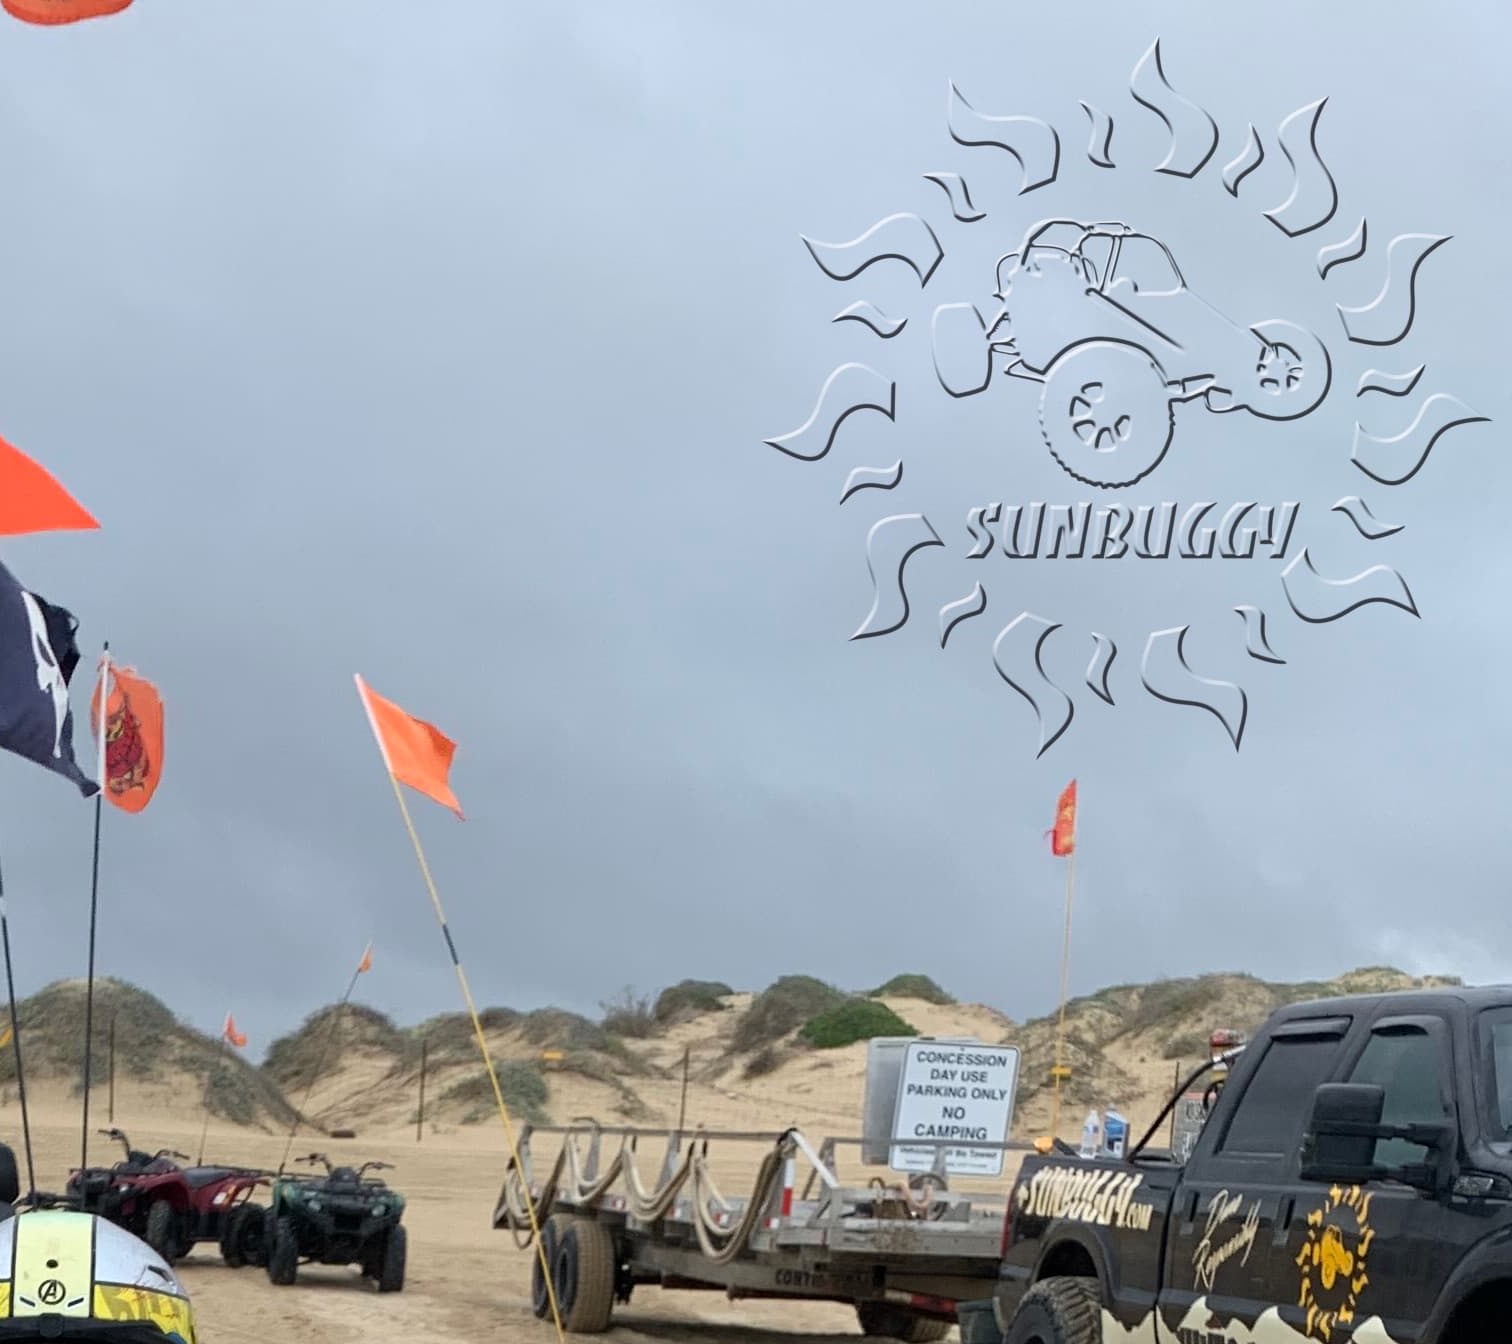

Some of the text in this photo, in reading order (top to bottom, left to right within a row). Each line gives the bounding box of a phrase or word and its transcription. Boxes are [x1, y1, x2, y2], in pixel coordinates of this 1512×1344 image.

[916, 1051, 1007, 1067] CONCESSION
[930, 1069, 988, 1083] DAY USE
[907, 1085, 1007, 1101] PARKING ONLY
[942, 1106, 966, 1120] NO
[914, 1123, 988, 1140] CAMPING
